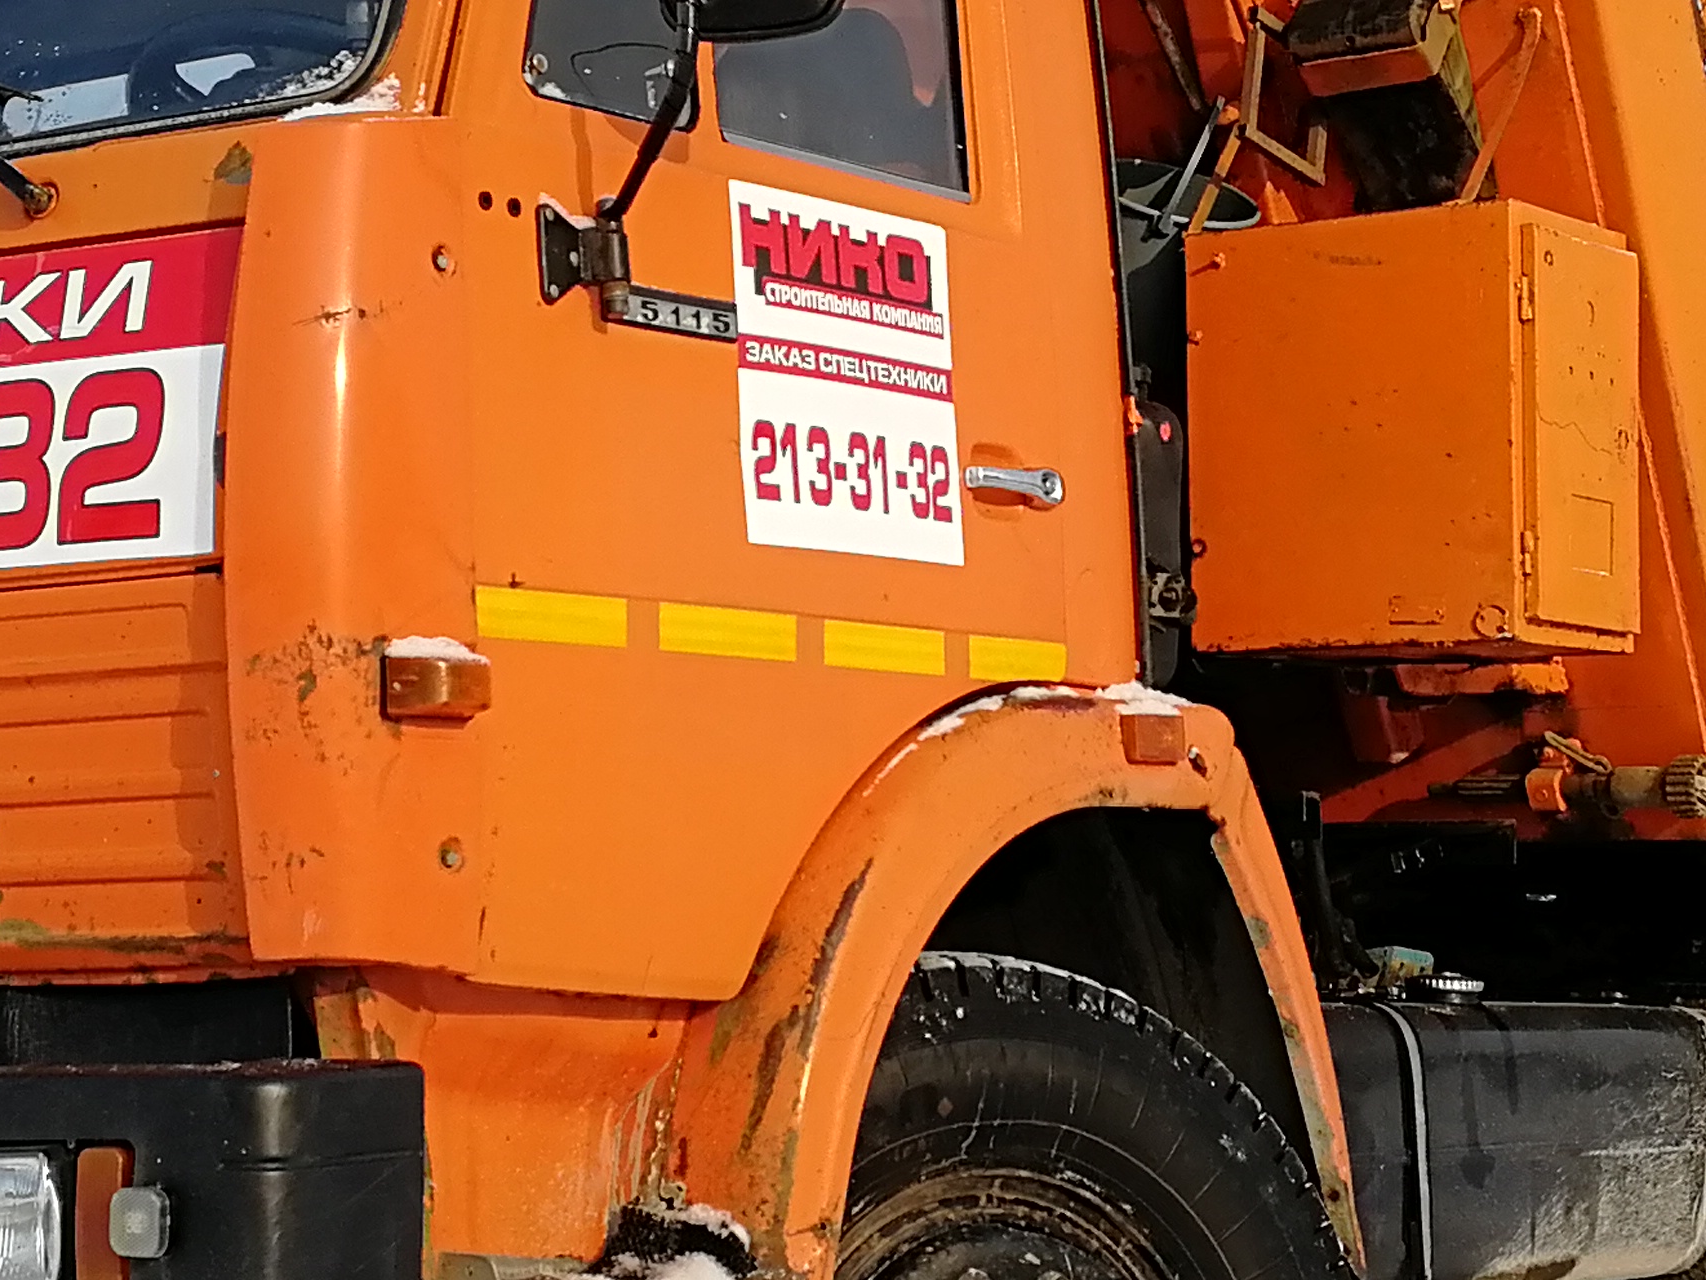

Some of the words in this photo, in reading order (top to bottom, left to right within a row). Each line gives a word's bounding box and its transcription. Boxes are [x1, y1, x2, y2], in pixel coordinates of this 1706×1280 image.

[738, 201, 929, 304] НИКО
[764, 281, 871, 321] СТРОИТЕЛЬНАЯ
[872, 302, 943, 335] КОМПАНИЯ
[745, 340, 816, 370] ЗАКАЗ
[819, 351, 948, 395] СПЕЦТЕХНИКИ
[751, 419, 953, 523] 213-31-32
